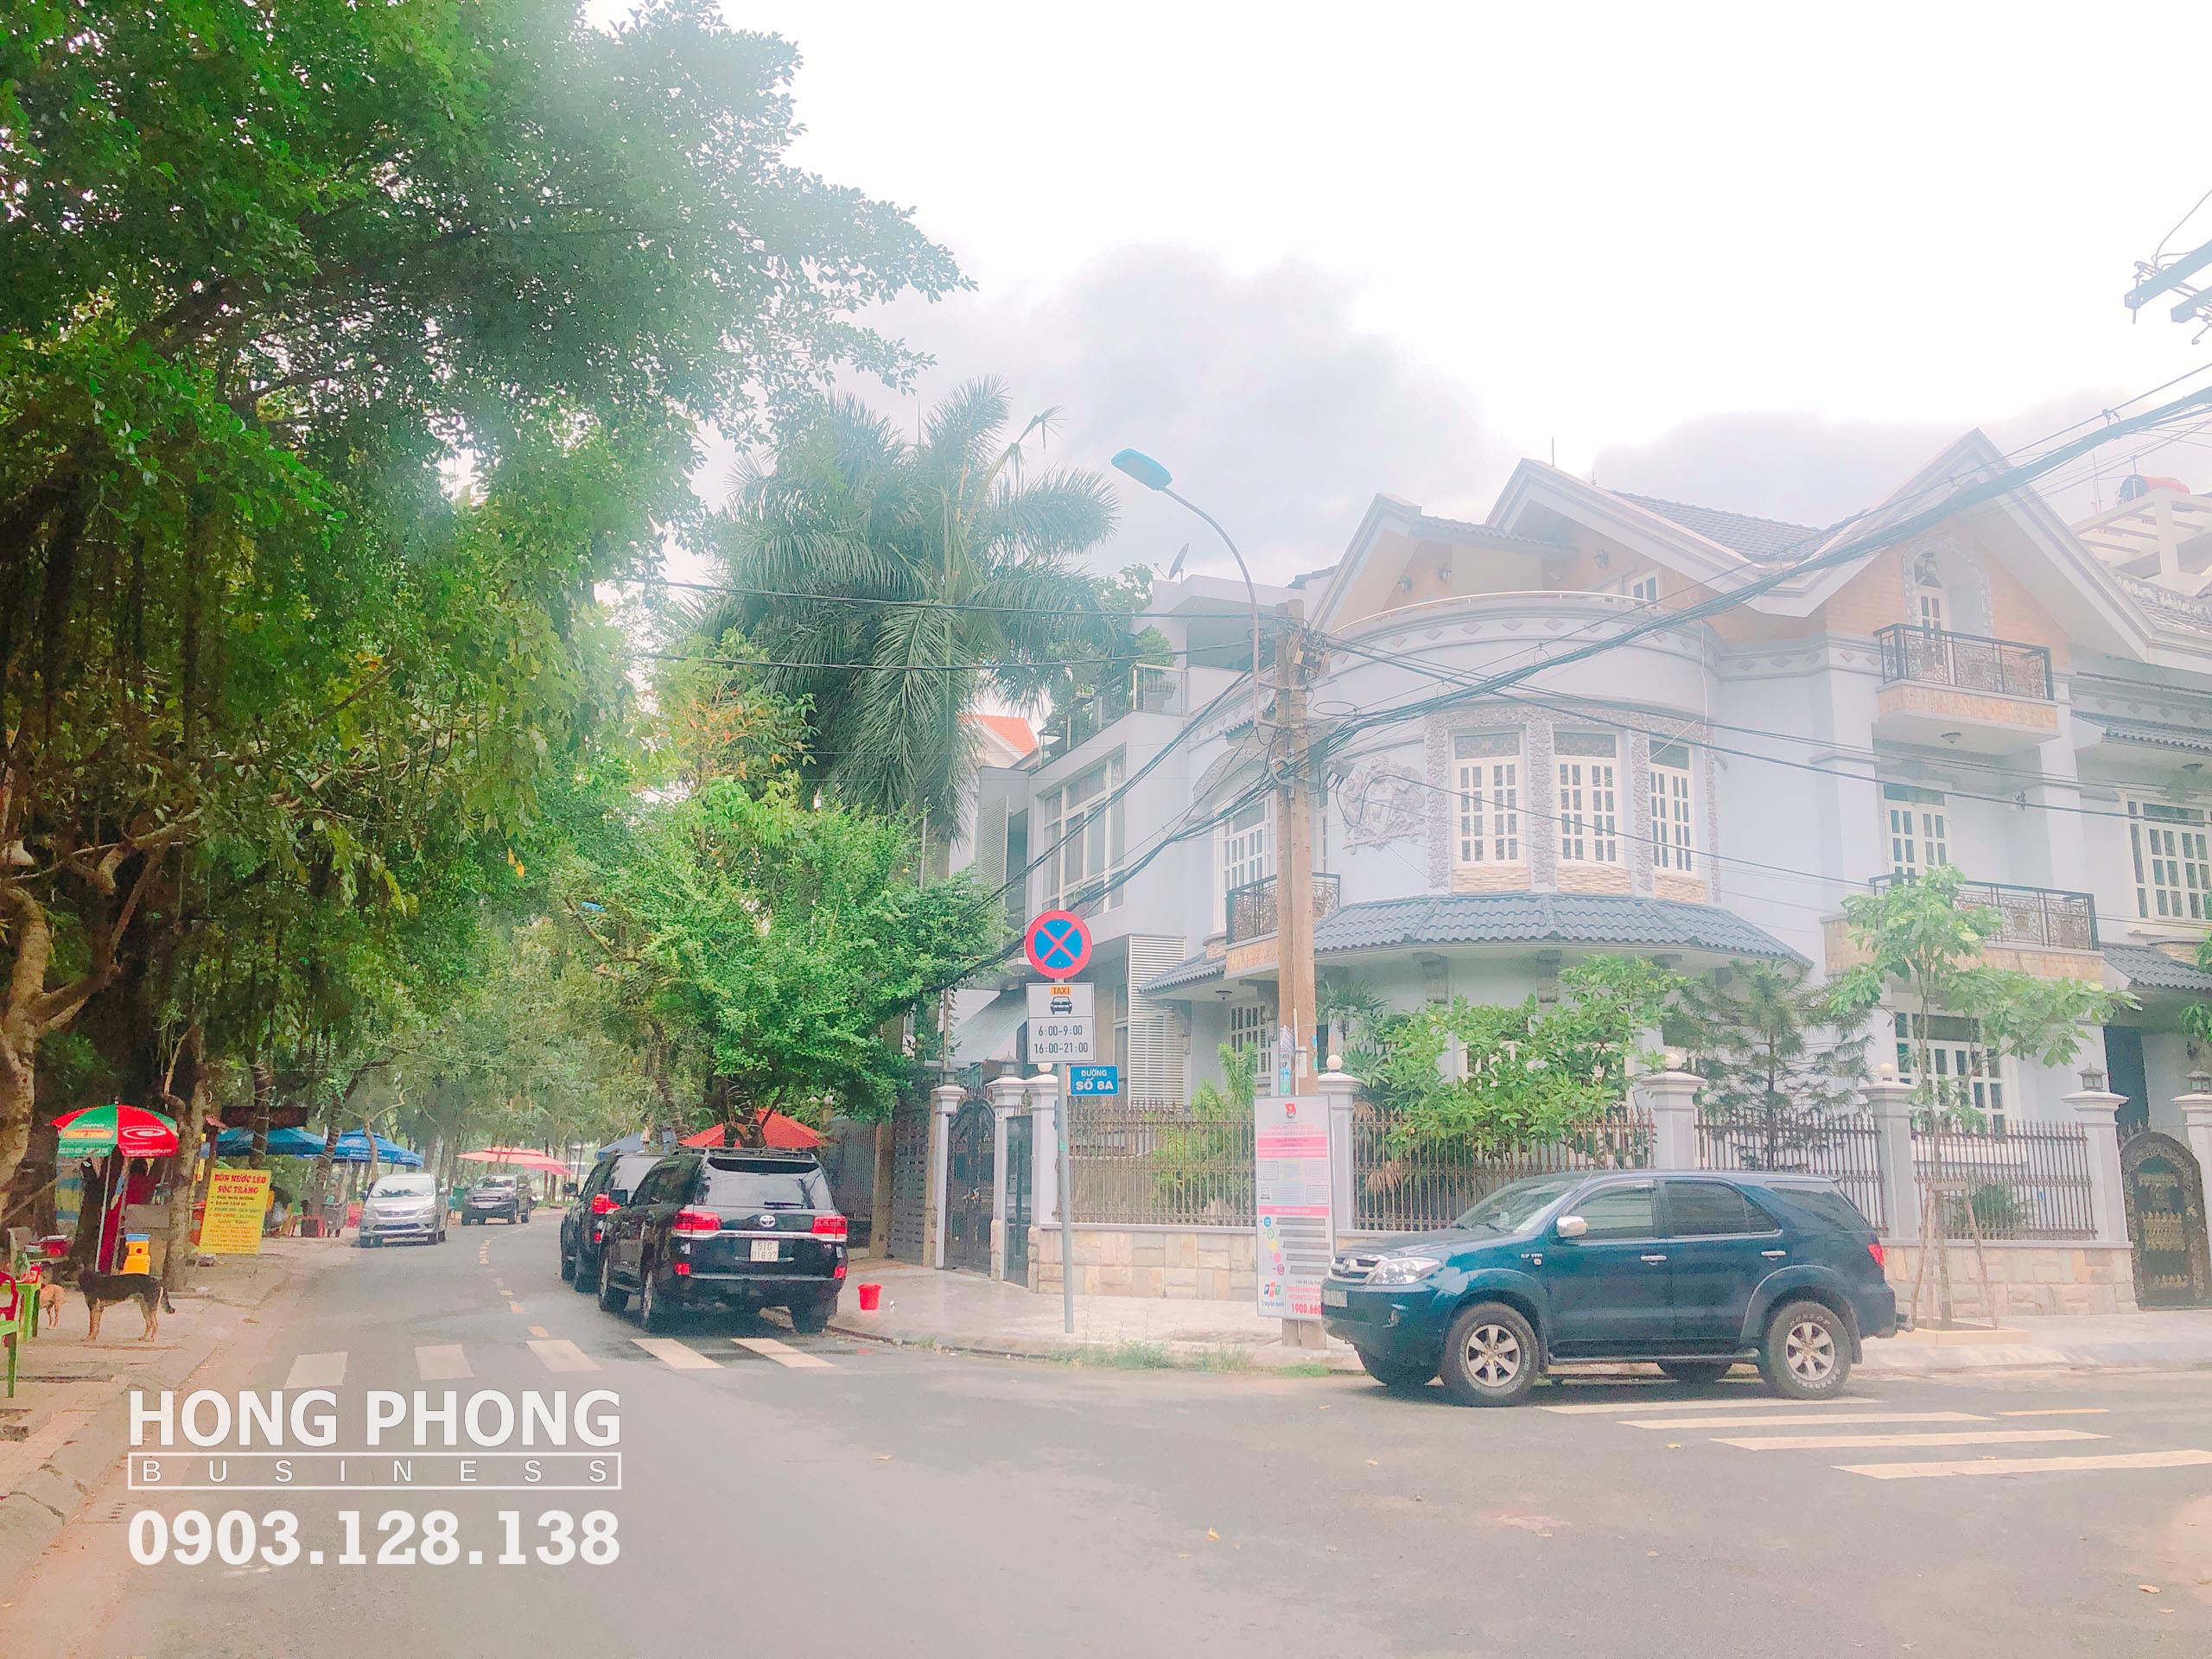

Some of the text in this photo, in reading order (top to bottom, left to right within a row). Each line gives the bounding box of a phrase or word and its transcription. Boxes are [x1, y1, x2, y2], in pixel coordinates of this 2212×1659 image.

[1052, 987, 1071, 995] TAXI
[1038, 1025, 1083, 1037] 6:00-9:00
[1034, 1042, 1088, 1054] 16:00-21:00
[1081, 1068, 1108, 1077] ĐƯỜNG
[1075, 1077, 1114, 1090] SỐ 8A
